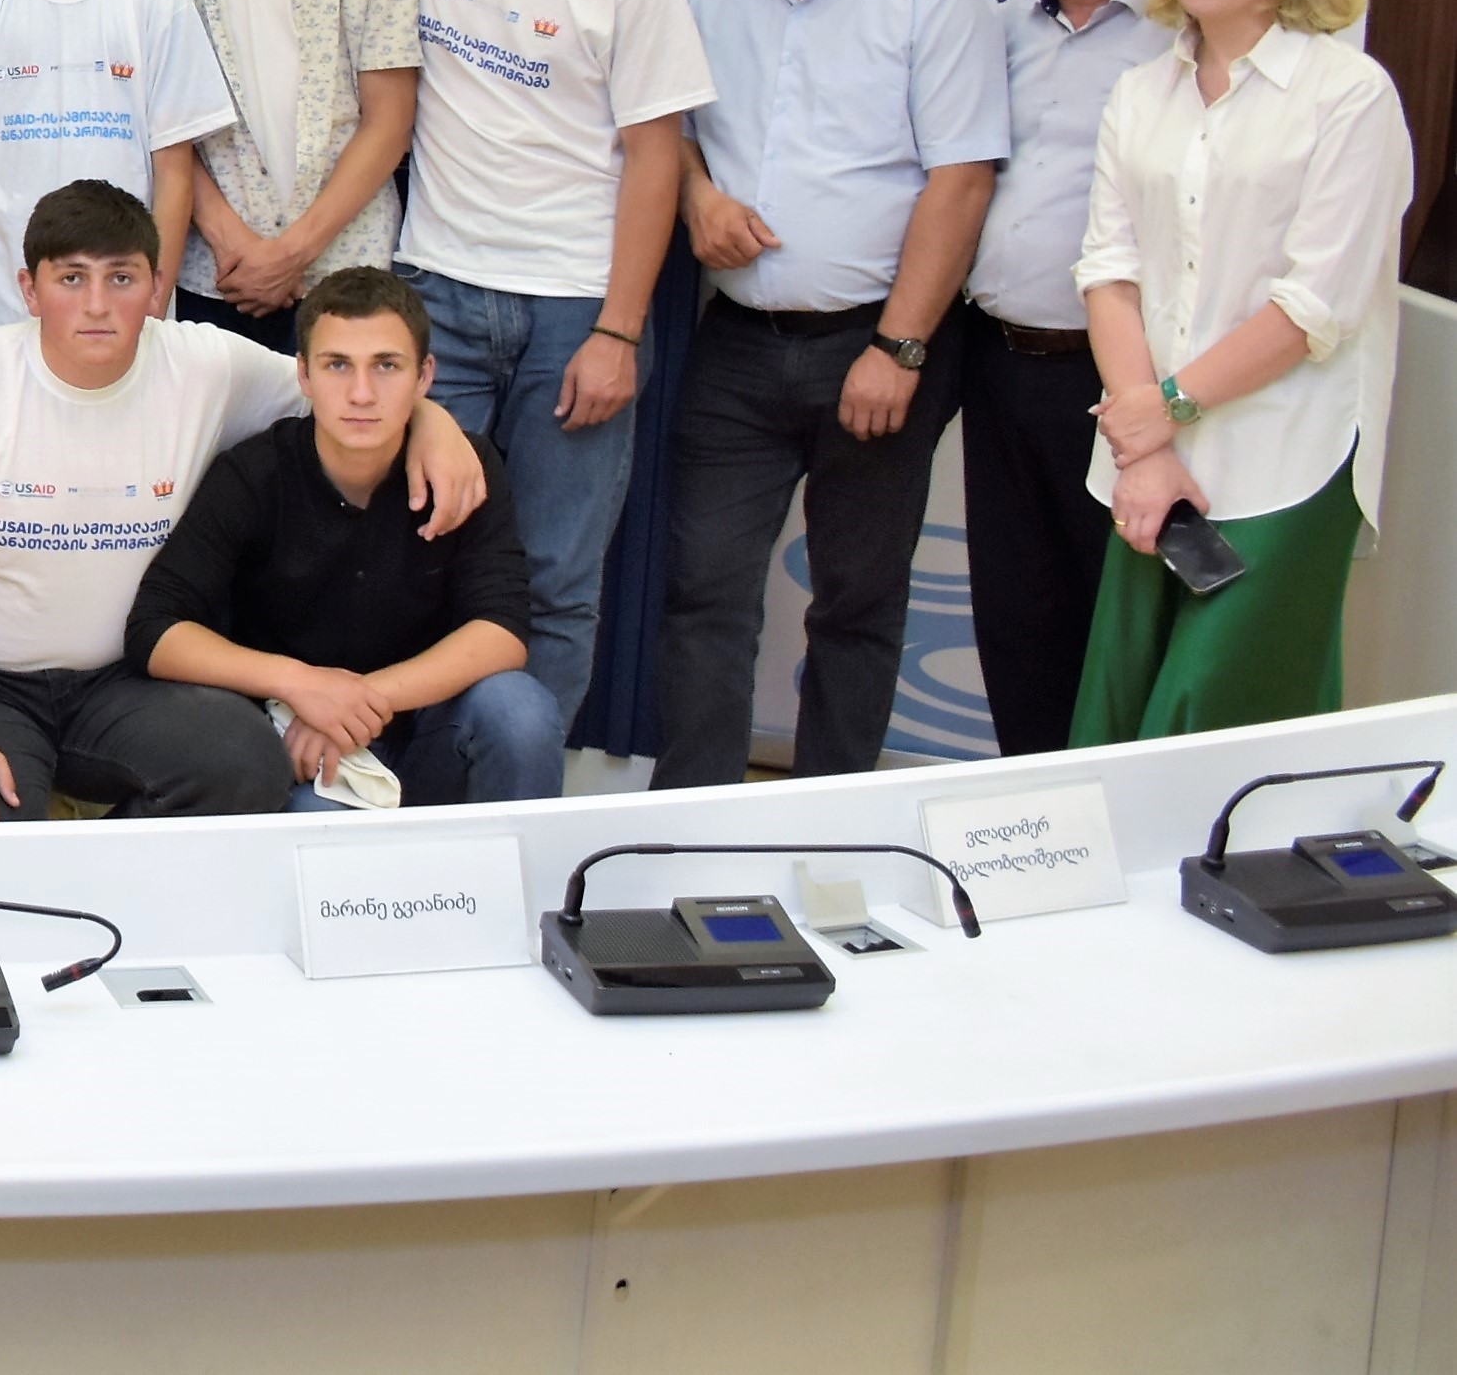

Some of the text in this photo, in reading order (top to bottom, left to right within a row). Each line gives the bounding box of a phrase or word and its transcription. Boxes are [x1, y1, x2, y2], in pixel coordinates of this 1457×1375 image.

[7, 65, 40, 77] USAID
[15, 483, 56, 496] USAID
[73, 518, 171, 536] სამოქალაქო
[965, 815, 1050, 849] ვლადიმერ
[320, 891, 477, 921] მარინე გვიანიძე
